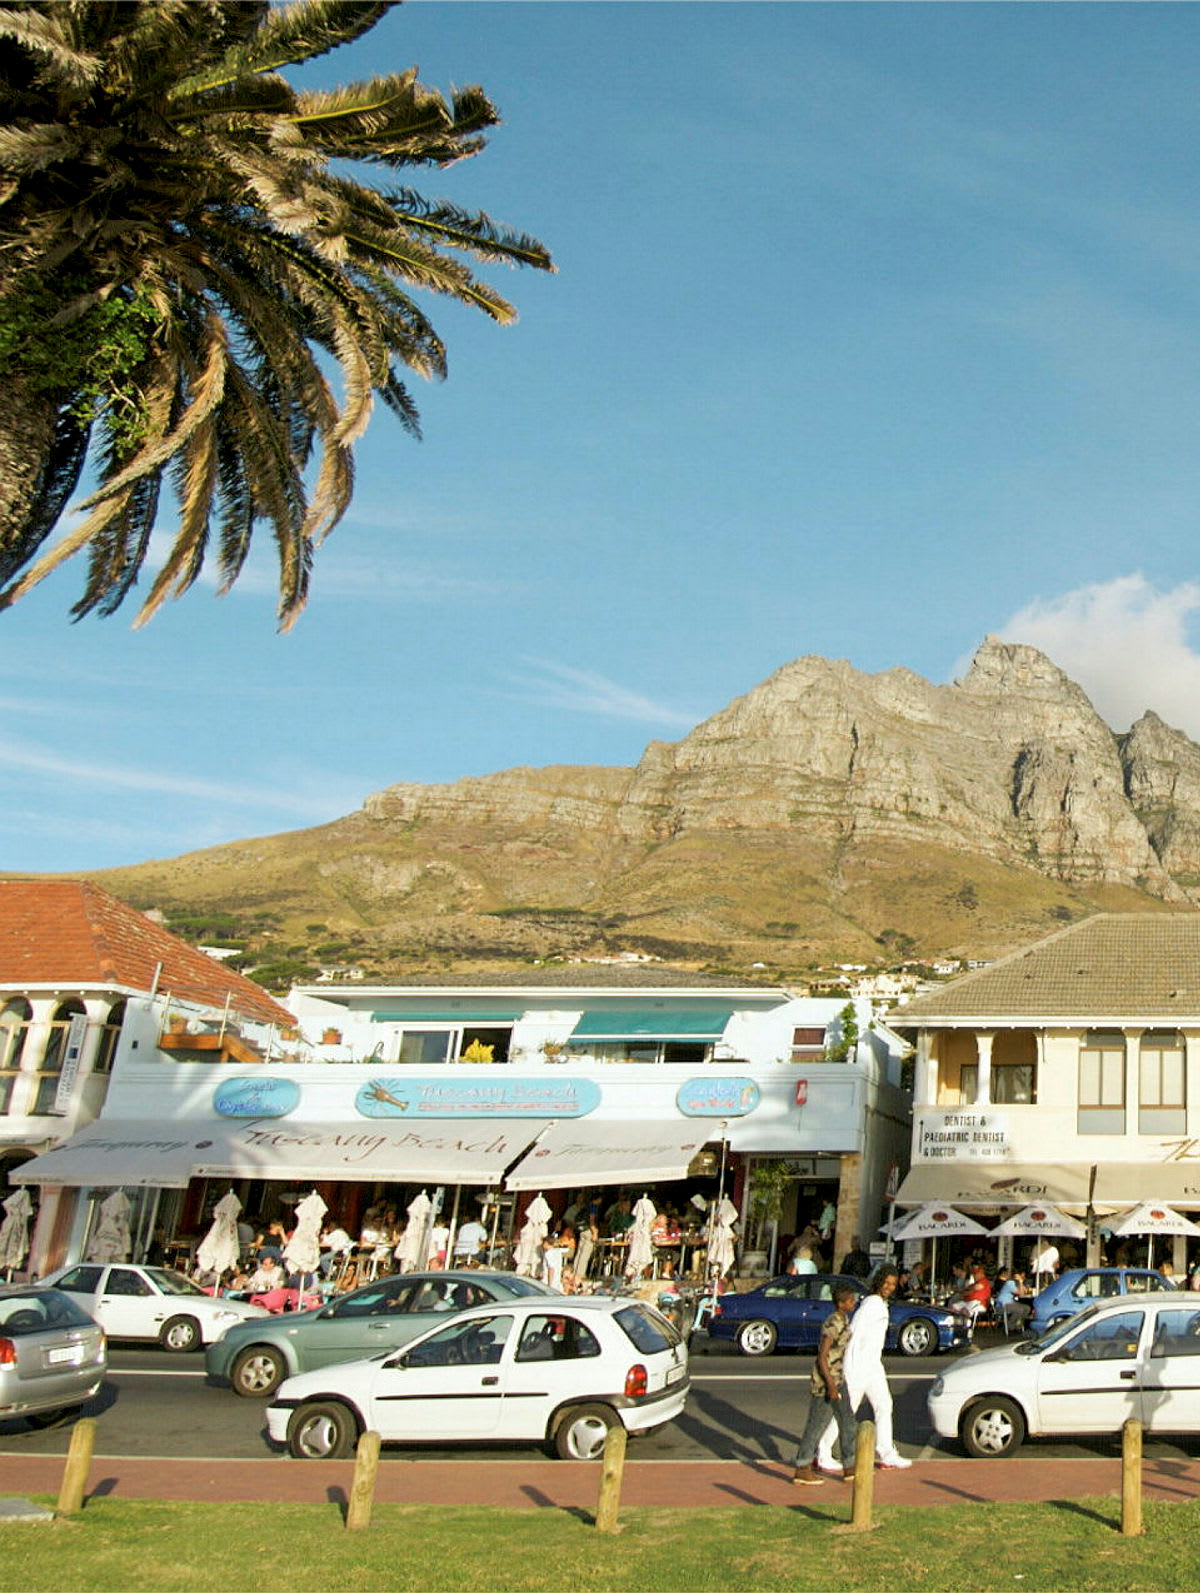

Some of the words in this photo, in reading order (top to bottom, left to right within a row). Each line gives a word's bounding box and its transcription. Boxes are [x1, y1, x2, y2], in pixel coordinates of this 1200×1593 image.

[944, 1115, 977, 1126] DENTIST
[980, 1116, 987, 1127] &
[924, 1132, 969, 1142] PAEDIATRIC
[973, 1132, 1004, 1142] DENTIST
[919, 1221, 967, 1231] BACARDI
[1013, 1221, 1062, 1229] BACARDI
